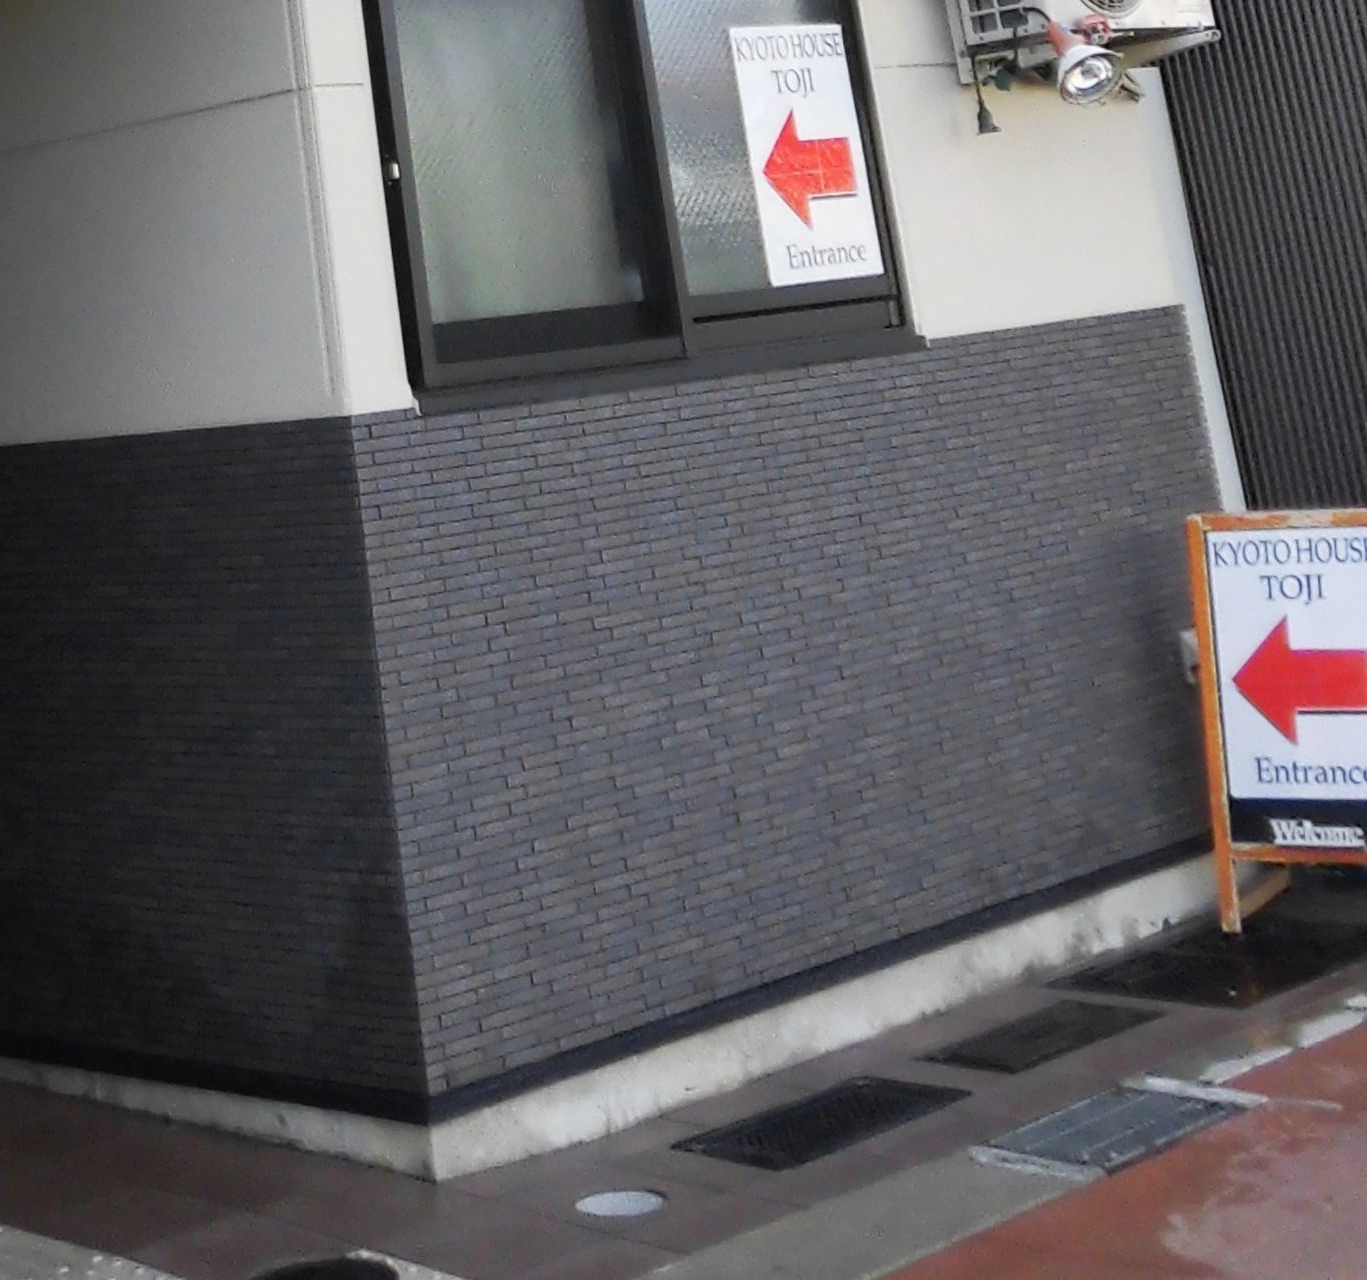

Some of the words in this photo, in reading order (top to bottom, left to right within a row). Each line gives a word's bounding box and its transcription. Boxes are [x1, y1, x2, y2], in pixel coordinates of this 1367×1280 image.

[734, 34, 790, 62] KYOTO
[789, 32, 843, 58] HOUSE
[770, 67, 815, 98] TOJI
[786, 243, 867, 270] Entrance
[1212, 539, 1291, 566] KYOTO
[1259, 574, 1327, 605] TOJI
[1254, 755, 1367, 784] Entranc
